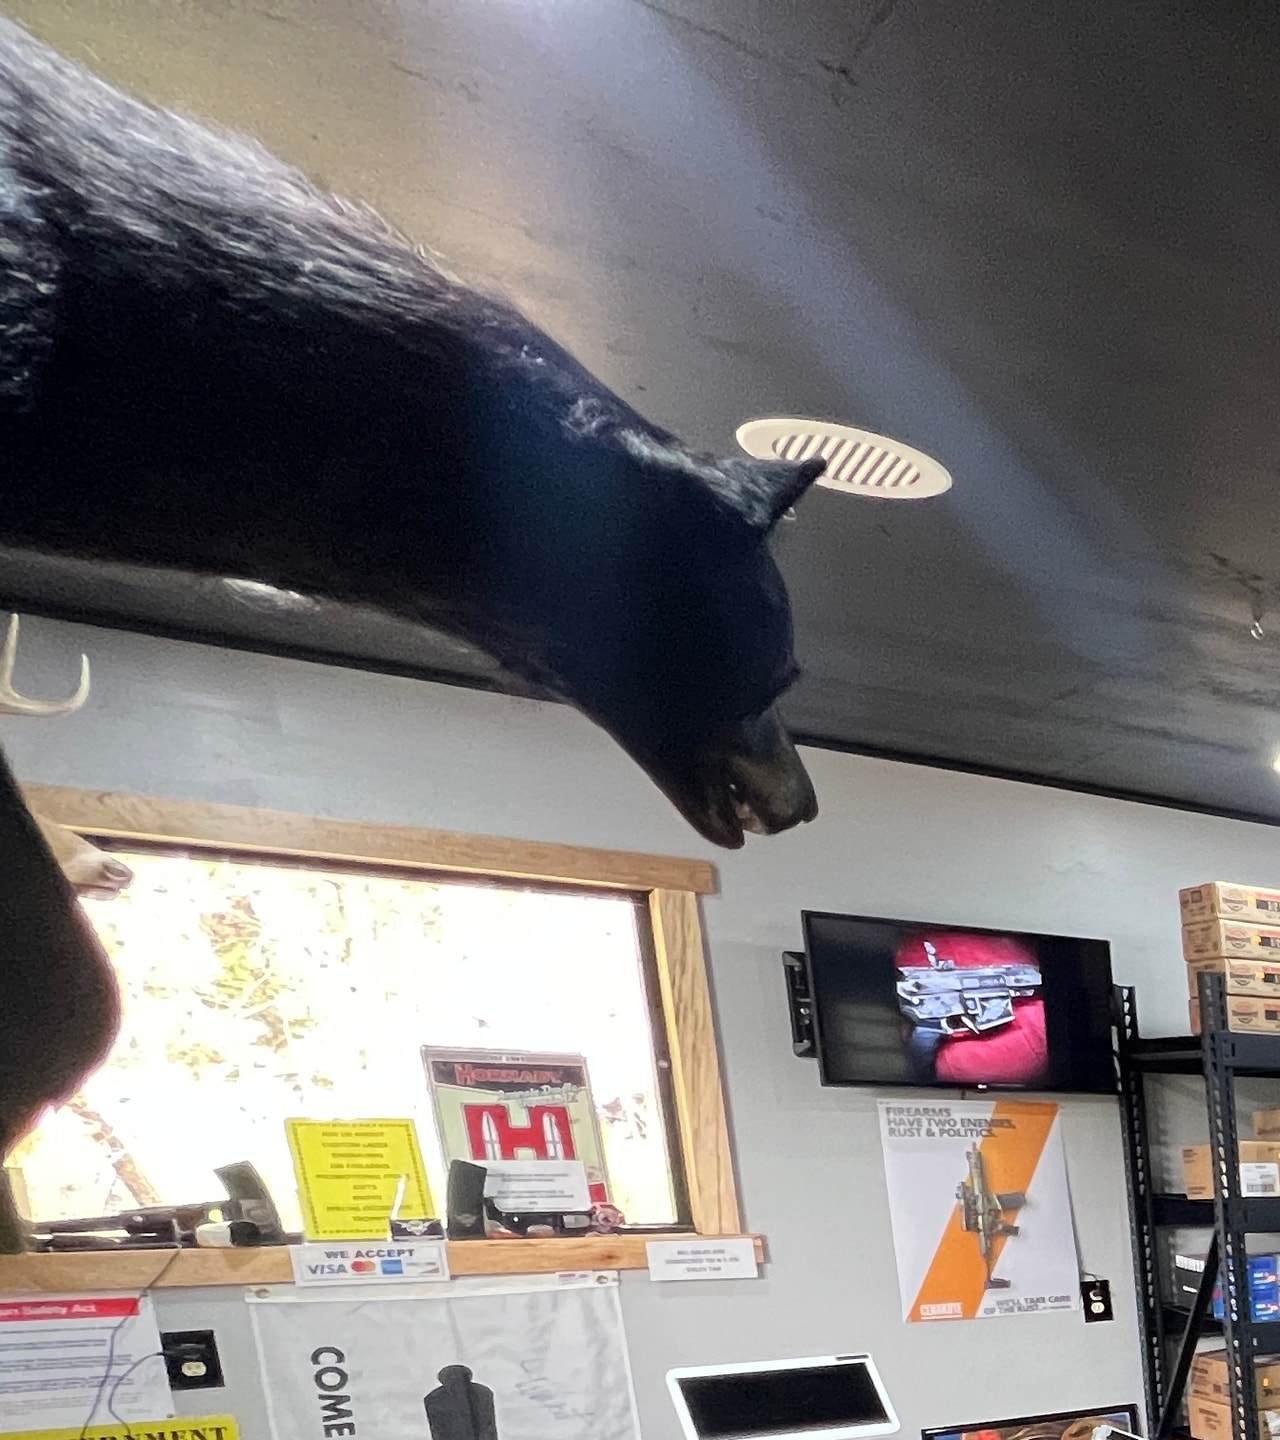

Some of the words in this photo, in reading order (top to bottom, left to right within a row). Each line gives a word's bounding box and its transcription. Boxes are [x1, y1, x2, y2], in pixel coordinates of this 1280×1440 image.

[886, 1107, 951, 1117] FIREARMS
[888, 1118, 923, 1127] HAVE
[925, 1118, 957, 1127] TWO
[889, 1128, 921, 1137] RUST
[926, 1128, 936, 1137] &
[325, 1250, 349, 1259] WE
[354, 1249, 415, 1259] ACCEPT
[307, 1264, 348, 1275] VISA
[310, 1346, 356, 1439] COME
